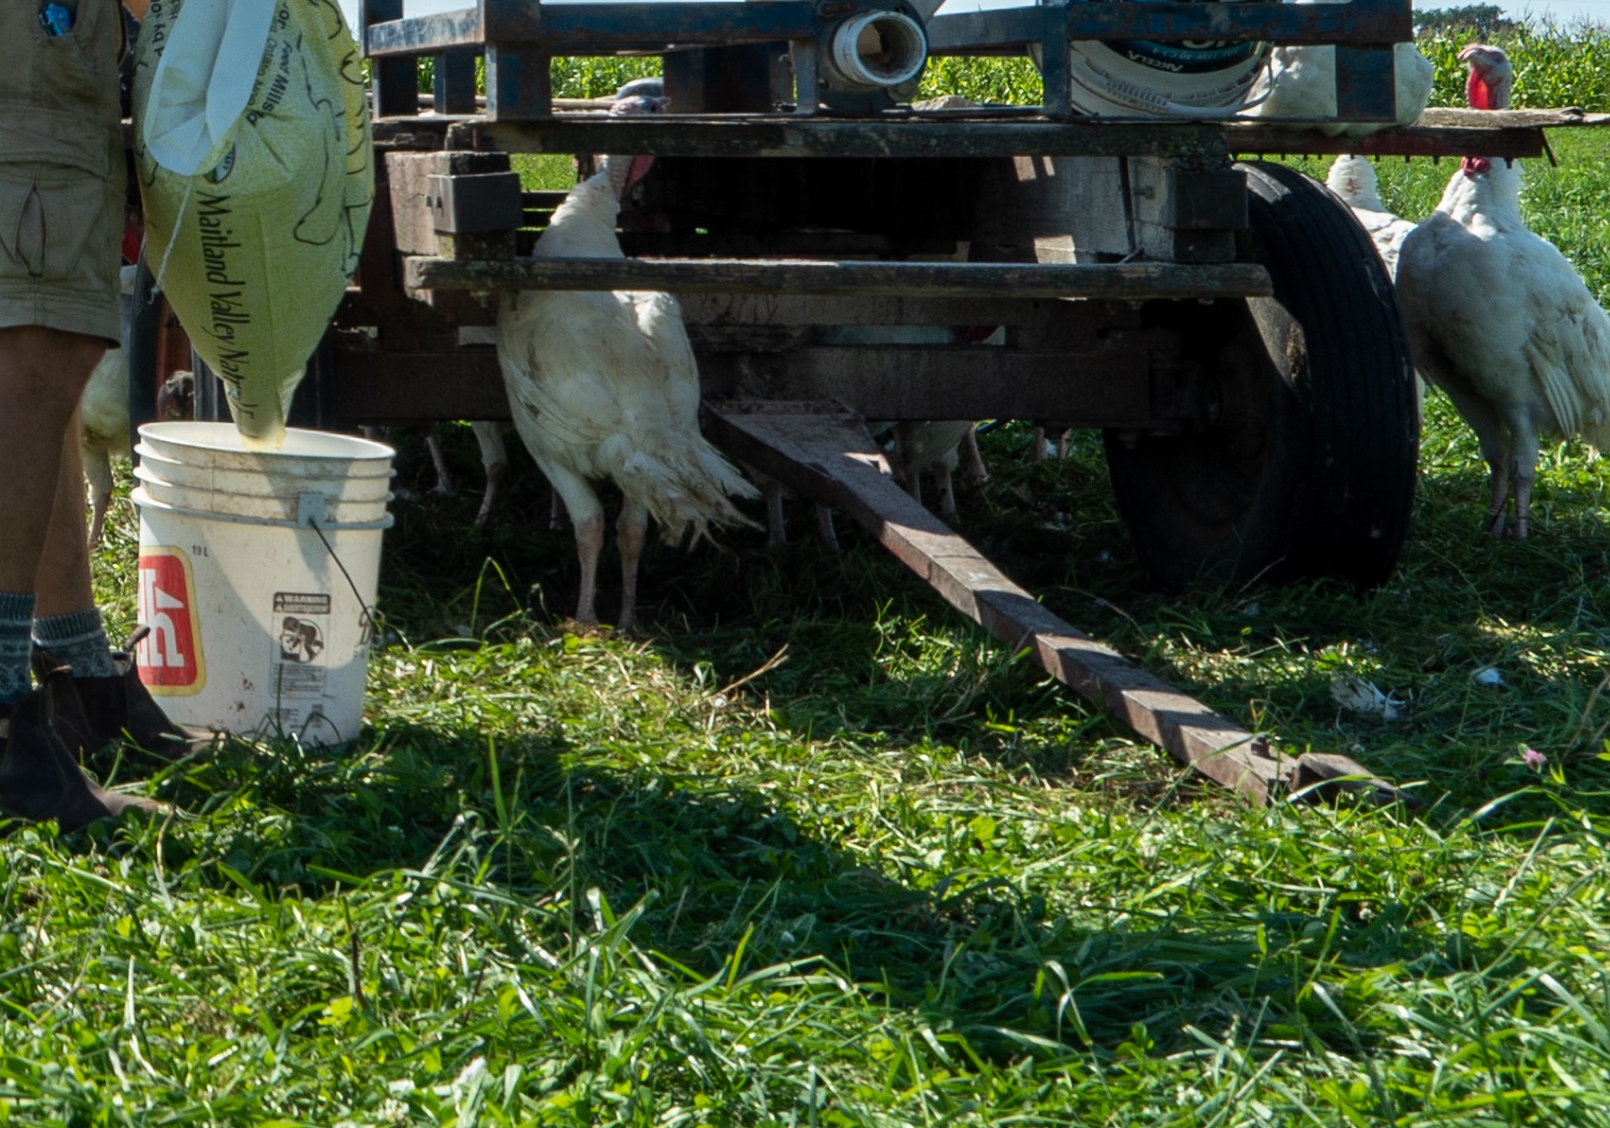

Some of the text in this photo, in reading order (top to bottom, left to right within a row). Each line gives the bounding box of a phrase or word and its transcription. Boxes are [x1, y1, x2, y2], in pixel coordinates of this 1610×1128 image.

[152, 24, 166, 44] by
[1128, 50, 1184, 72] AKCELA
[262, 74, 288, 112] Mills
[196, 190, 246, 286] Maitland
[201, 290, 250, 345] Valley
[204, 547, 210, 557] L
